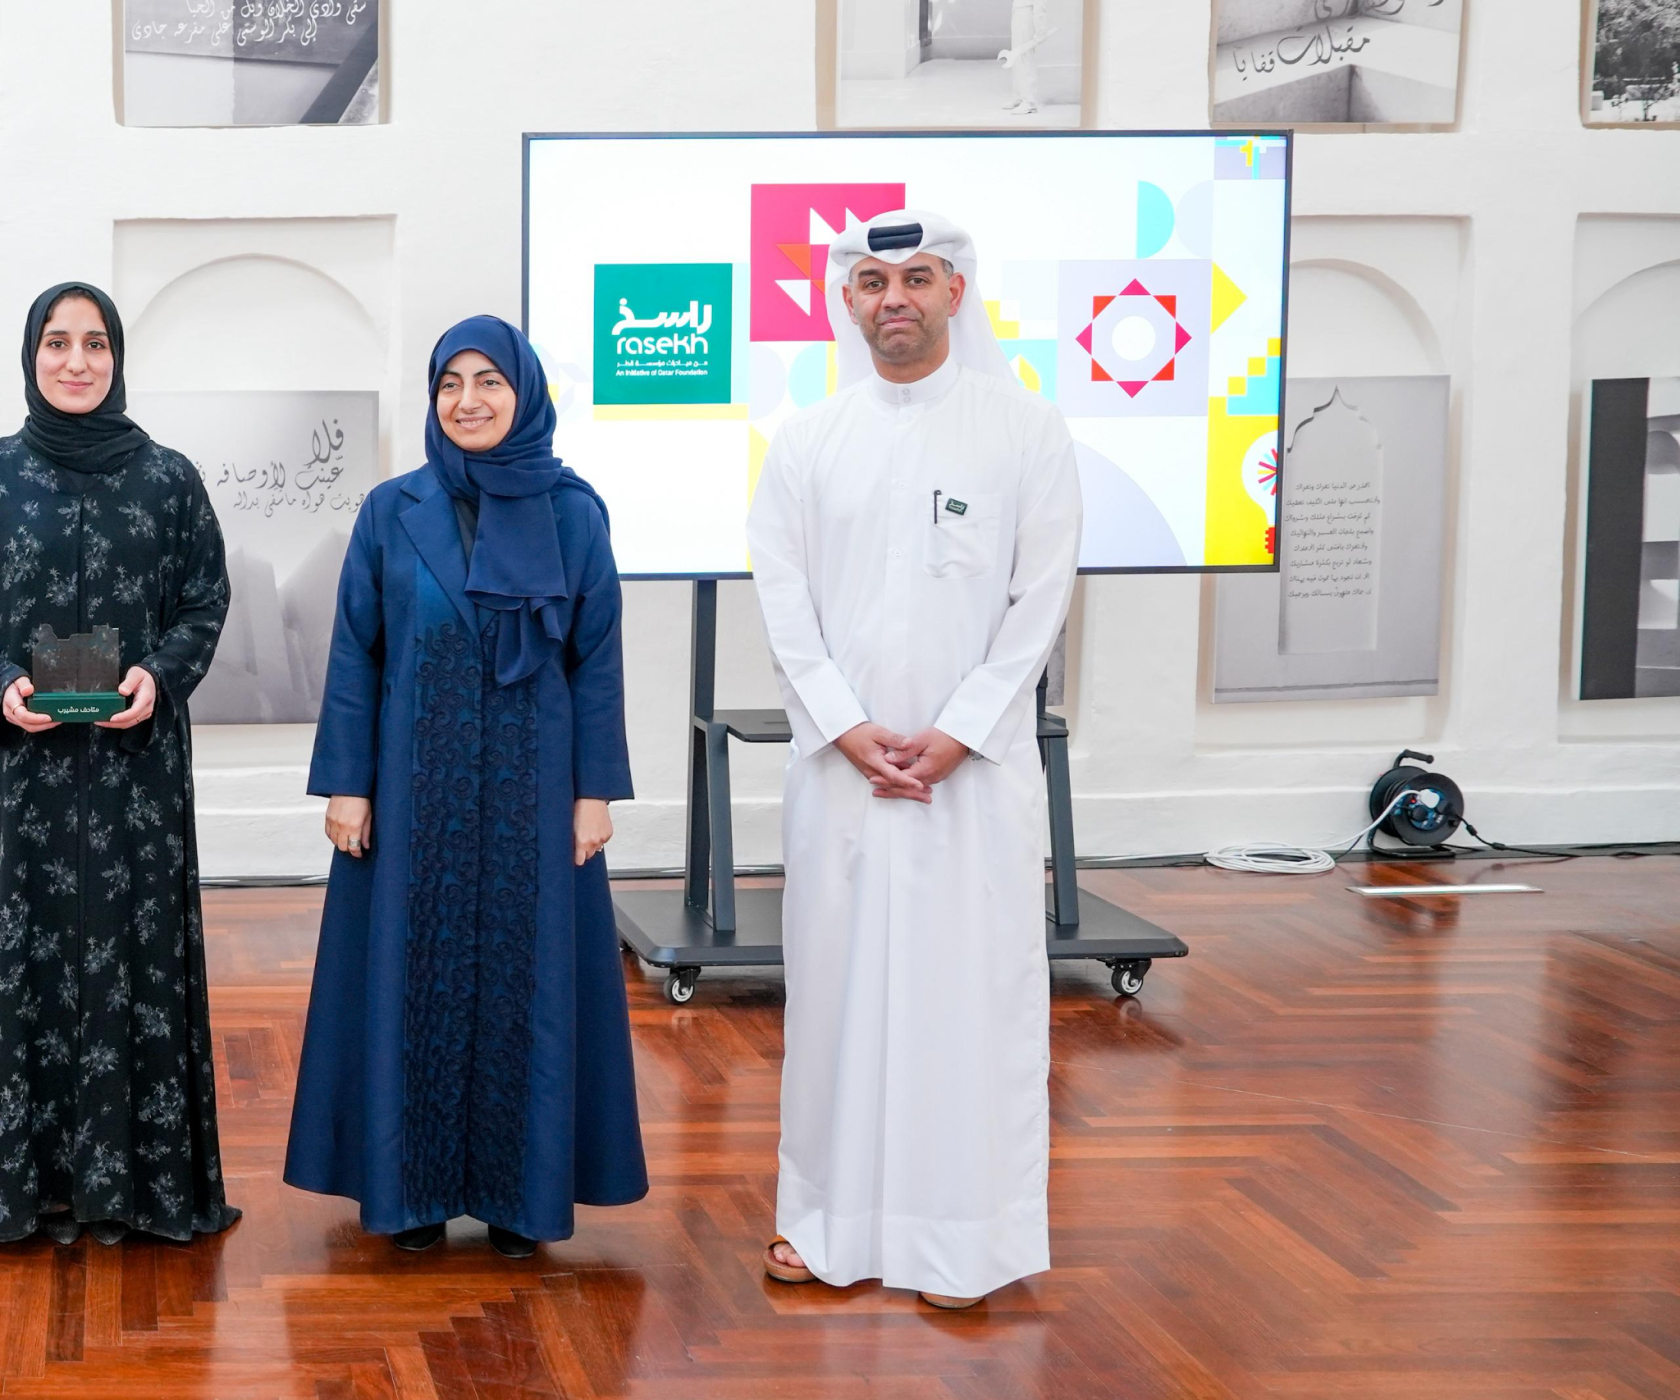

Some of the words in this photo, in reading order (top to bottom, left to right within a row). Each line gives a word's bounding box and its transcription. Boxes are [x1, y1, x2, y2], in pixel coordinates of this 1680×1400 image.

[611, 297, 712, 335] راسخ
[616, 333, 708, 354] rasekh
[57, 705, 79, 714] مشيرب
